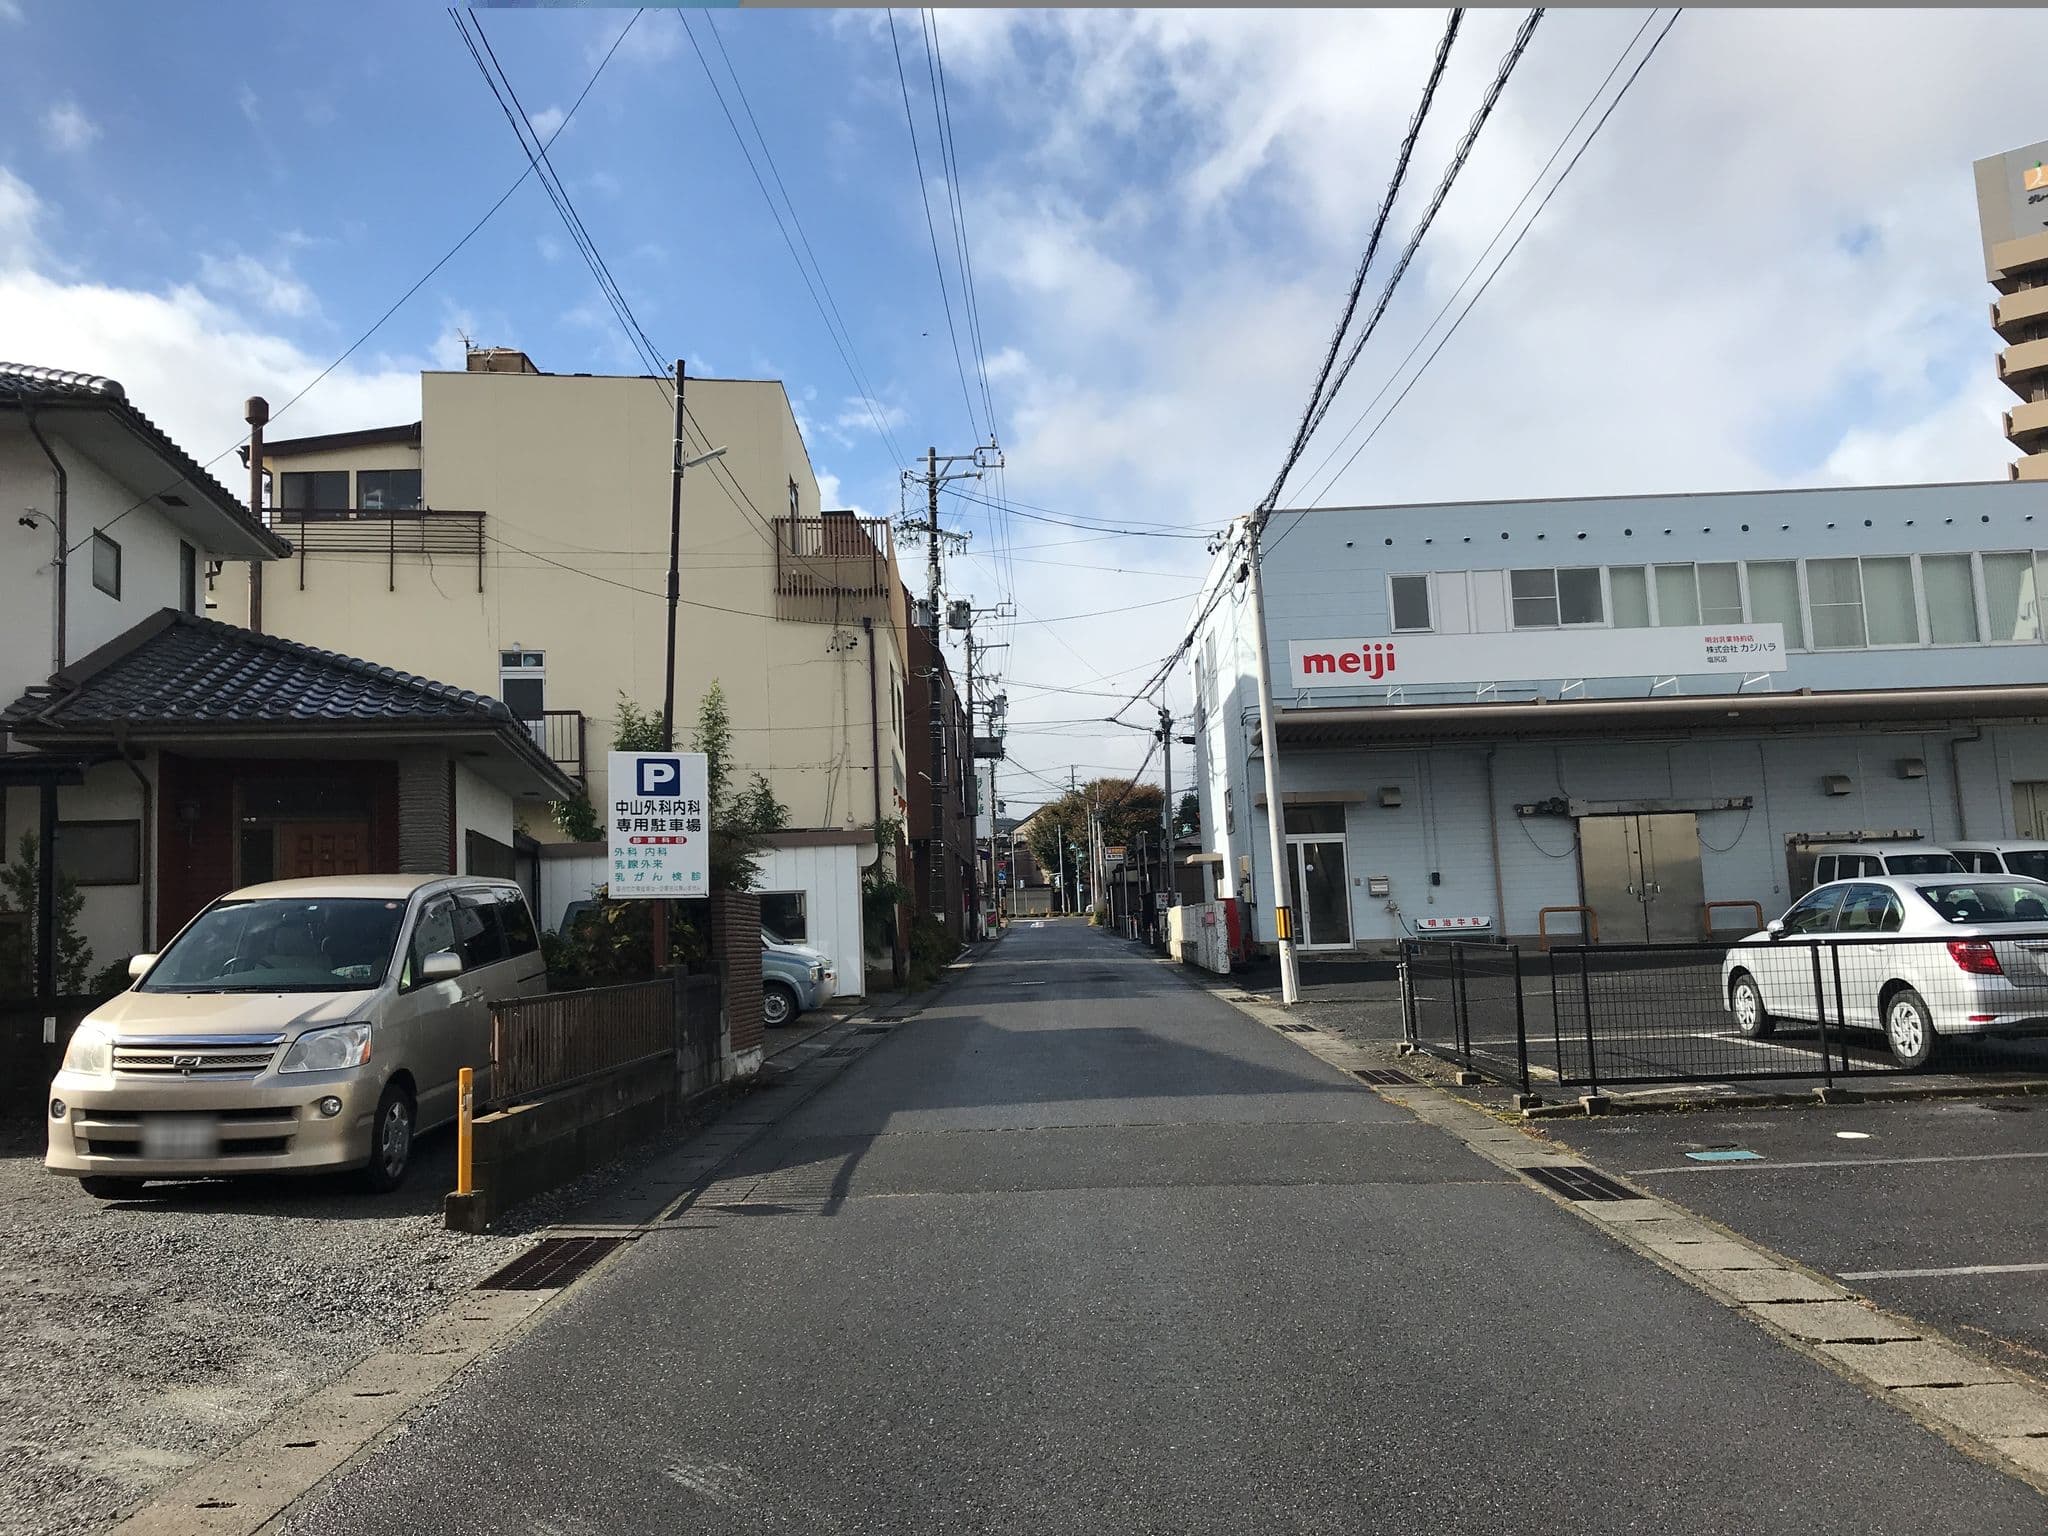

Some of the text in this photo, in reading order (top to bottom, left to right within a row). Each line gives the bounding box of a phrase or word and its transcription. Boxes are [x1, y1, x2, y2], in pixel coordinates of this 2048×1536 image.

[1706, 643, 1777, 654] 株式会社 カジハラ
[1303, 643, 1395, 679] meiji
[643, 763, 675, 792] P
[615, 799, 701, 816] 中山外科内科
[616, 818, 702, 832] 専用駐車場
[614, 847, 667, 856] 外科 内科
[614, 859, 663, 869] 乳腺外来
[614, 871, 701, 882] 乳がん検診
[1427, 917, 1481, 928] 明治牛乳
